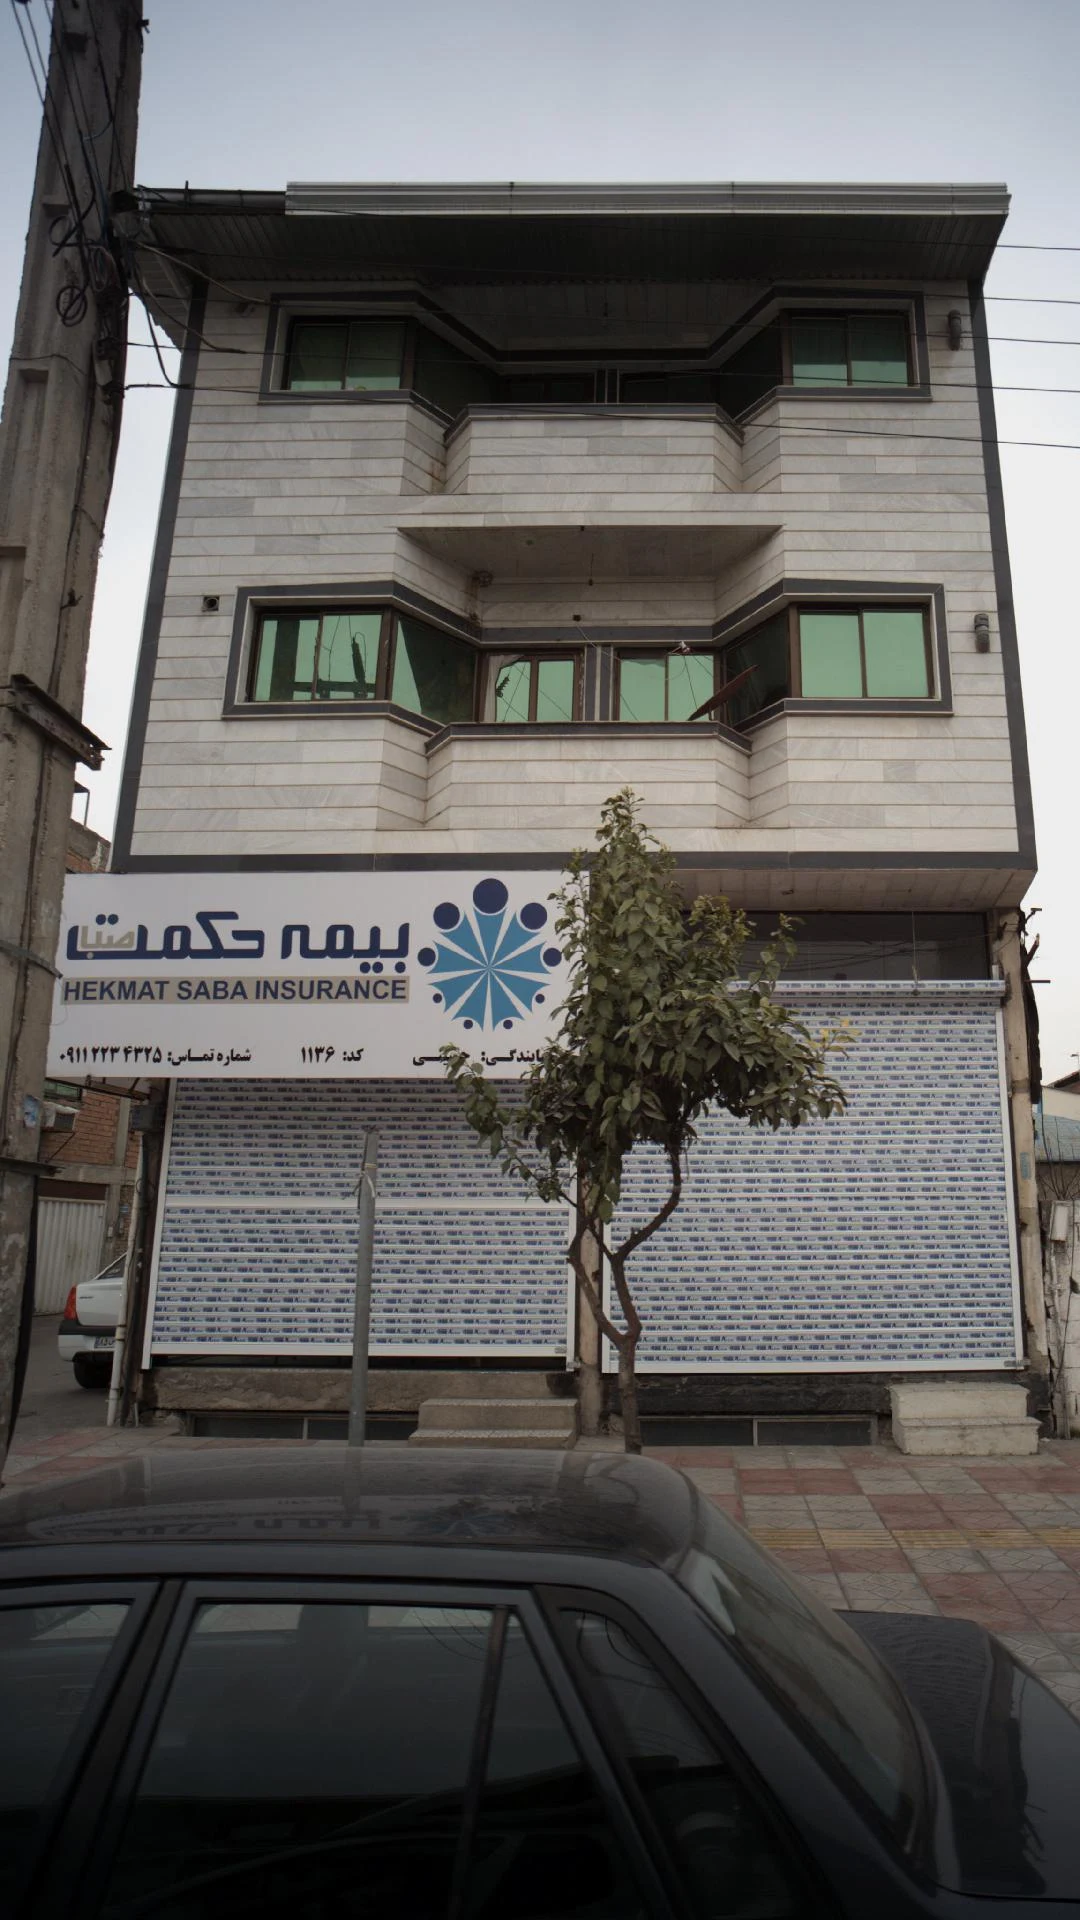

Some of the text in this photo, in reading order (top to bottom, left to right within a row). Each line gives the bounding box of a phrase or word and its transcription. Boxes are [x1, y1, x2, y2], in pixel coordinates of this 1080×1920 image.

[66, 911, 410, 974] بیمه حکمت صبا
[63, 979, 407, 1000] HEKMAT SABA INSURANCE
[167, 1047, 215, 1067] تماس:
[216, 1048, 252, 1067] شماره
[301, 1045, 364, 1064] کد: ۱۱۳۶
